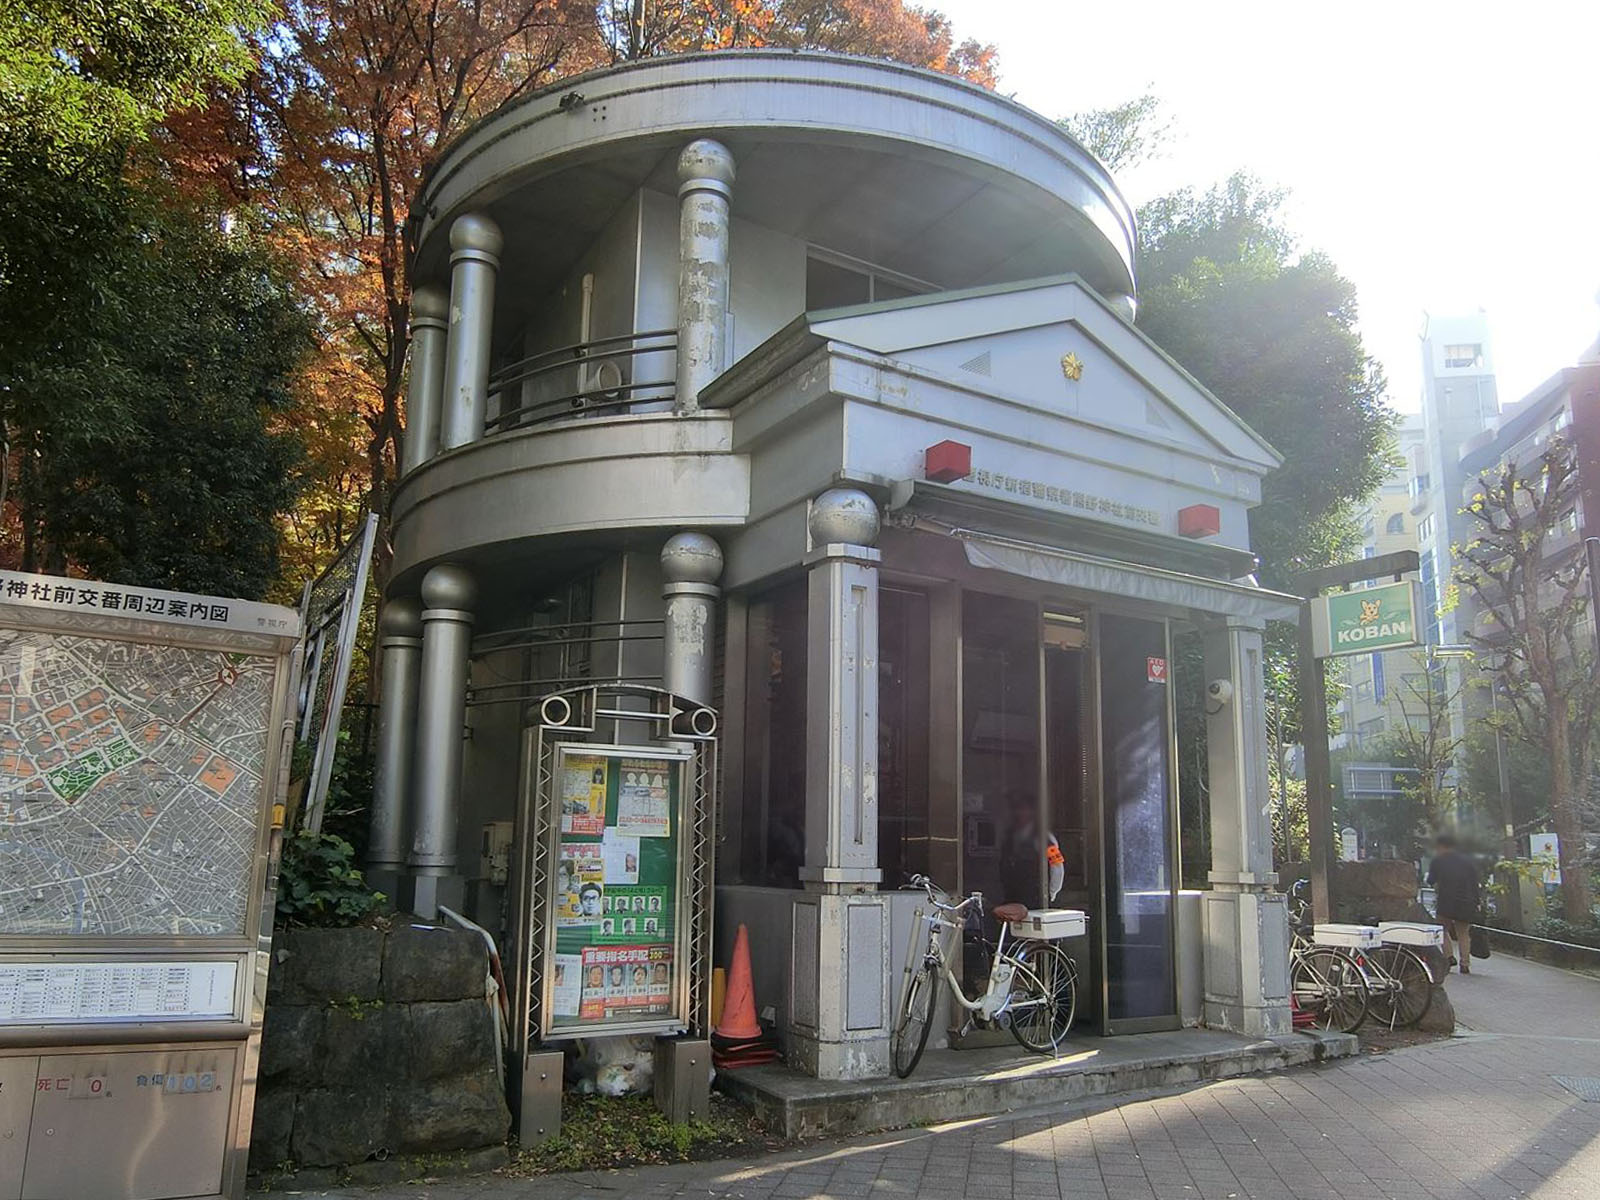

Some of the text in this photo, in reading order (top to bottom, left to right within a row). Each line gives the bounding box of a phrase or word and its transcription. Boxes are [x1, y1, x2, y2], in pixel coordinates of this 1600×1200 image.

[0, 578, 229, 623] 神社前交番周辺案内図
[256, 617, 288, 629] 警視庁
[1338, 621, 1407, 643] KOBAN
[37, 1077, 71, 1092] 死亡
[91, 1079, 102, 1093] 0
